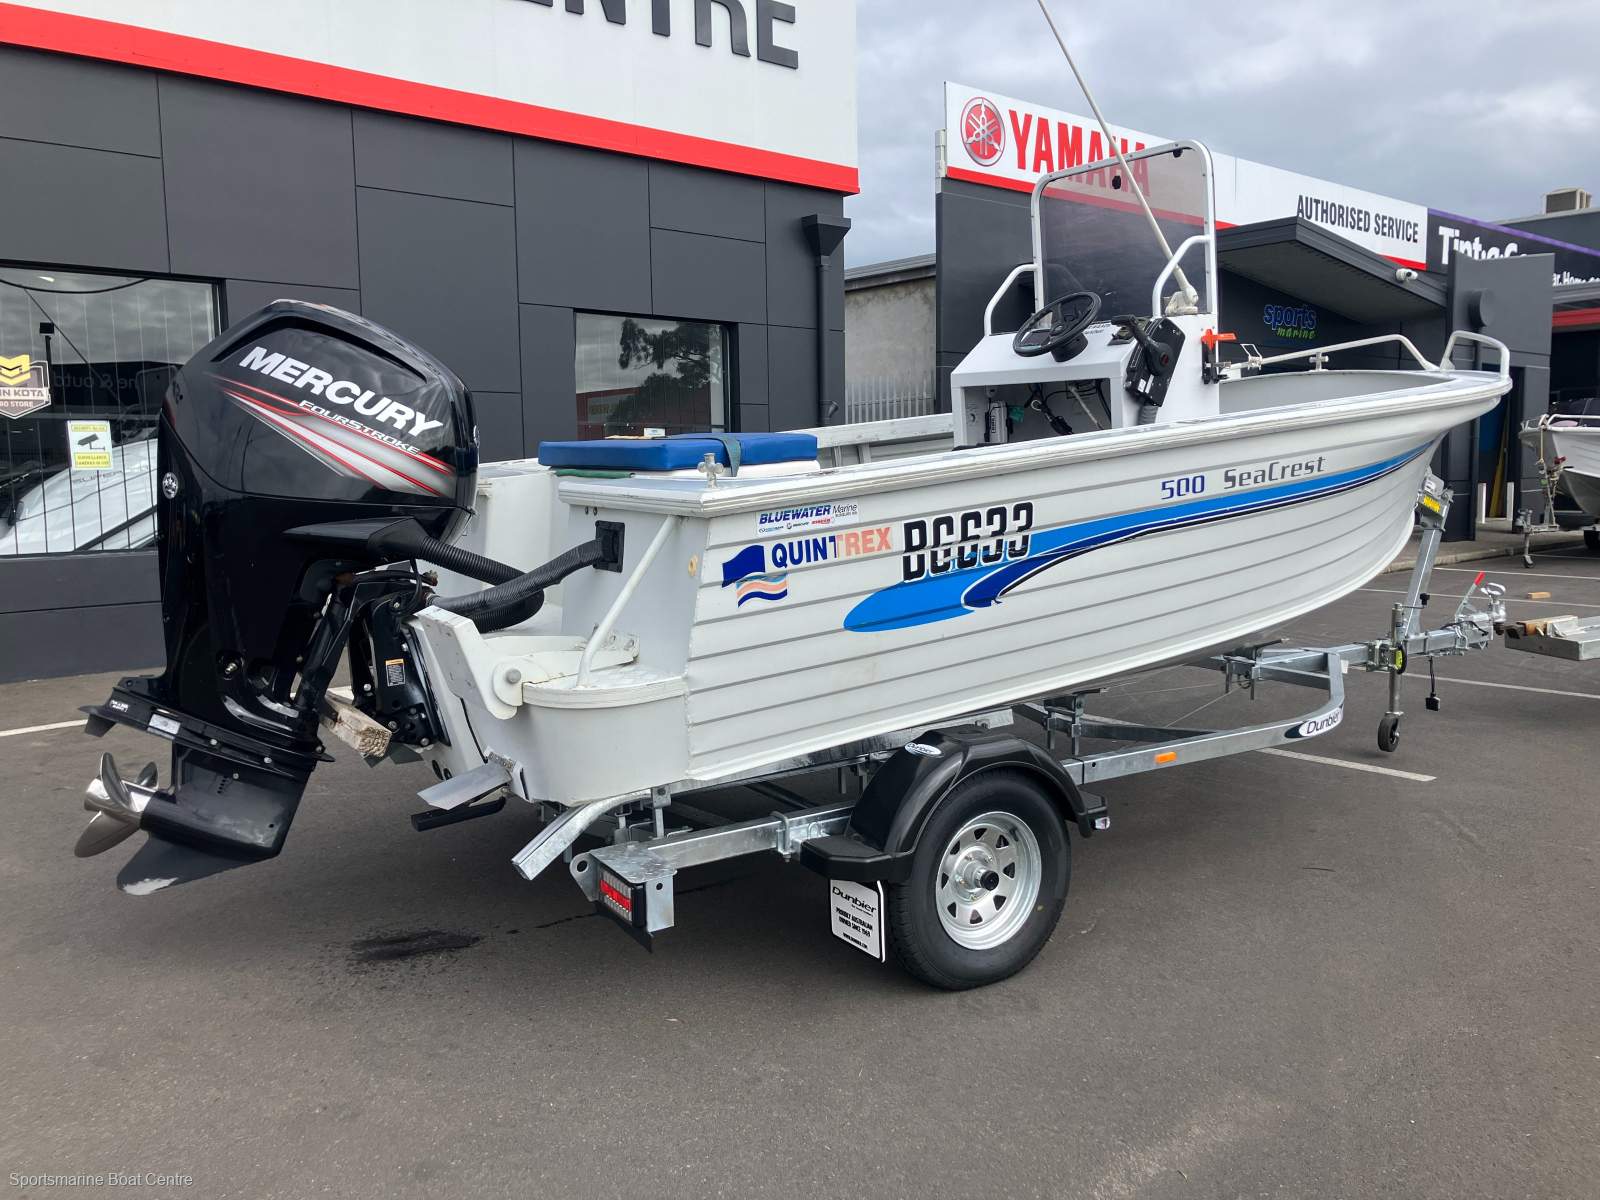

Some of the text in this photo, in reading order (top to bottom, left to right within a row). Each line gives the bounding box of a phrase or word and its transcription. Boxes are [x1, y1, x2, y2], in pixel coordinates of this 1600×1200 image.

[1297, 194, 1419, 244] AUTHORISED SERVICE
[1263, 304, 1317, 330] sports
[238, 346, 444, 437] MERCURY
[299, 400, 421, 455] FOURSTROKE
[1161, 456, 1326, 500] 500 SeaCrest
[759, 505, 832, 524] BLUEWATER
[832, 503, 858, 514] Marine
[771, 527, 892, 568] QUINTREX
[1306, 710, 1341, 735] Dunbier
[832, 886, 877, 913] Dunbier
